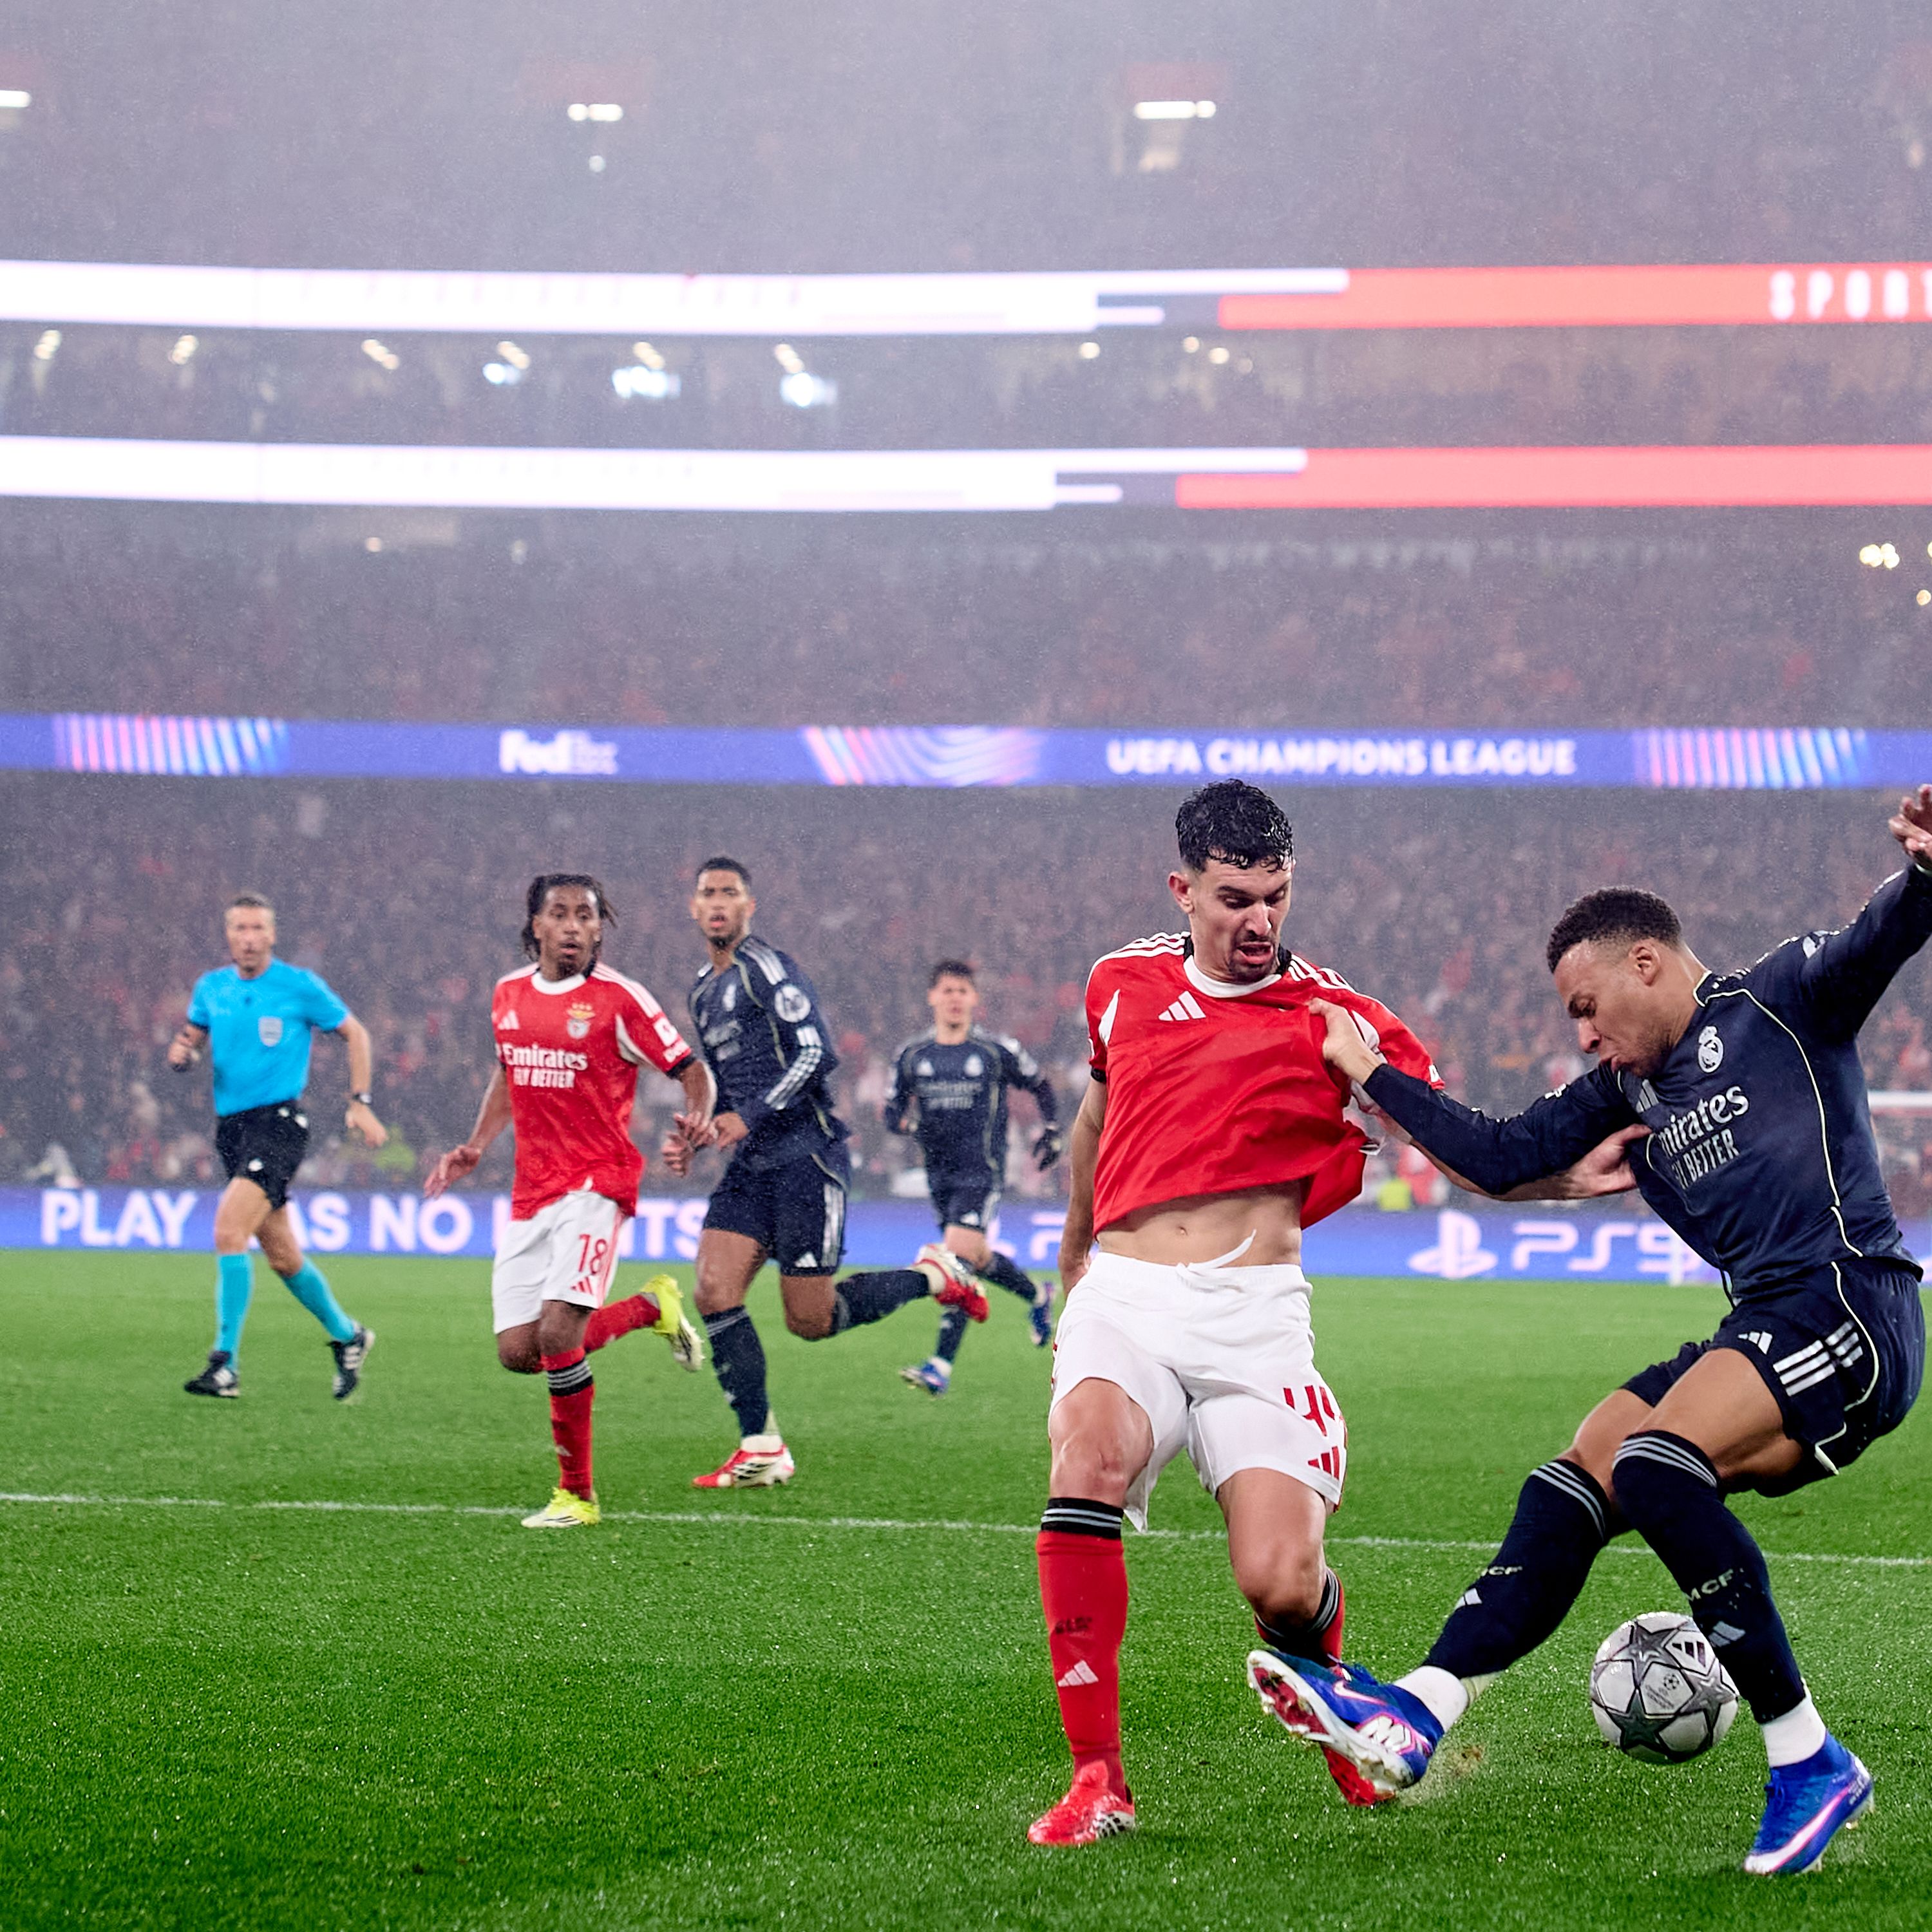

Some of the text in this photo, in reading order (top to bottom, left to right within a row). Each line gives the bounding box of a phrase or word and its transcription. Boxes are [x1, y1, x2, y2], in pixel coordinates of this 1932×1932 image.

[1106, 740, 1577, 776] UEFA CHAMPIONS LEAGUE
[502, 1042, 588, 1070] Emirates
[1658, 1086, 1749, 1159] mirates
[1683, 1128, 1740, 1182] BETTER
[41, 1189, 196, 1247] PLAY
[370, 1193, 473, 1253] NO
[578, 1234, 608, 1276] 18
